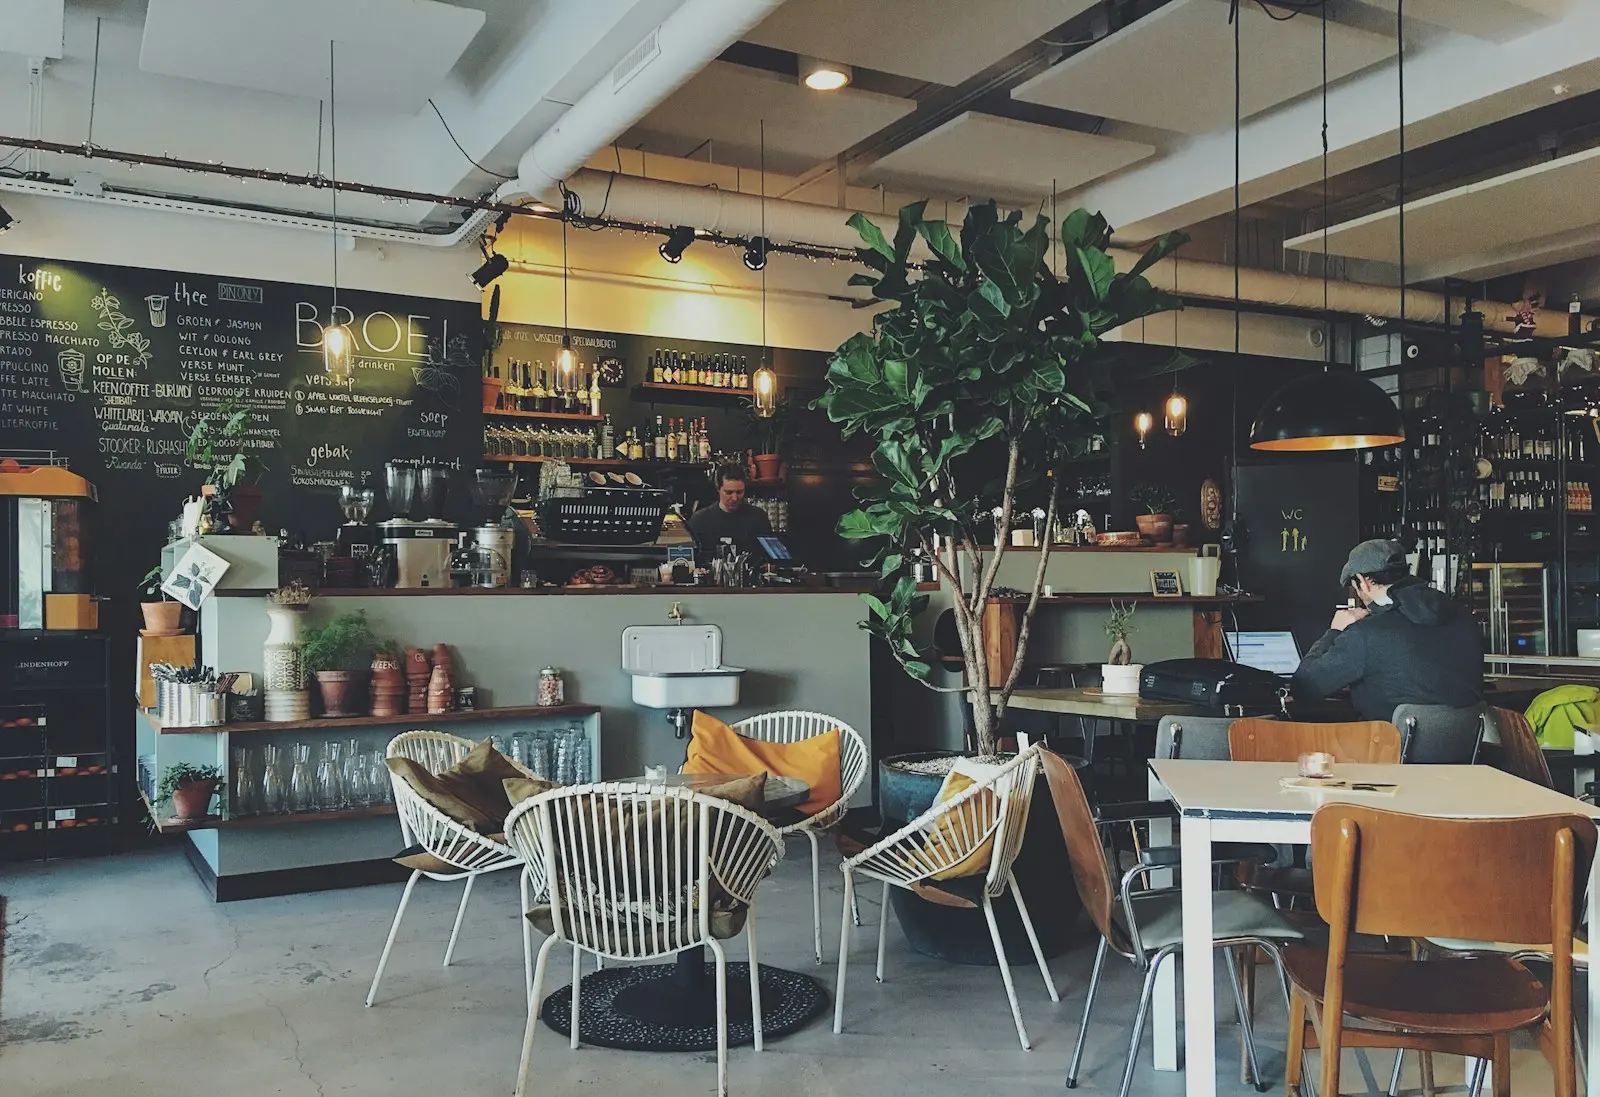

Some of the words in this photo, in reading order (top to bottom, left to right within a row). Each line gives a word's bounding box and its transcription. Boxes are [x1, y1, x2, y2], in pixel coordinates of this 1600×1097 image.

[19, 263, 62, 292] koffie
[0, 288, 43, 301] ERICANO
[174, 281, 208, 306] thee
[30, 318, 78, 331] ESPRESSO
[176, 314, 212, 327] GROEN
[295, 302, 448, 360] BROEI
[45, 333, 100, 347] MACCHIATO
[178, 332, 197, 342] WIT
[213, 335, 251, 346] OOLONG
[96, 353, 113, 364] OP
[116, 354, 131, 366] DE
[179, 345, 218, 358] CEYLON
[232, 350, 255, 361] EARL
[258, 352, 283, 362] GREY
[180, 360, 213, 371] VERSE
[217, 362, 245, 373] MUNT
[358, 359, 396, 372] drinken
[22, 376, 51, 387] LATTE
[180, 372, 211, 383] VERSE
[214, 373, 253, 385] GEMBER
[305, 373, 333, 387] vers
[21, 390, 76, 402] MACCHIATO
[254, 388, 292, 400] KRUIDEN
[16, 404, 49, 416] WHITE
[420, 411, 449, 428] soep
[306, 442, 351, 467] gebak
[1281, 509, 1303, 520] WC
